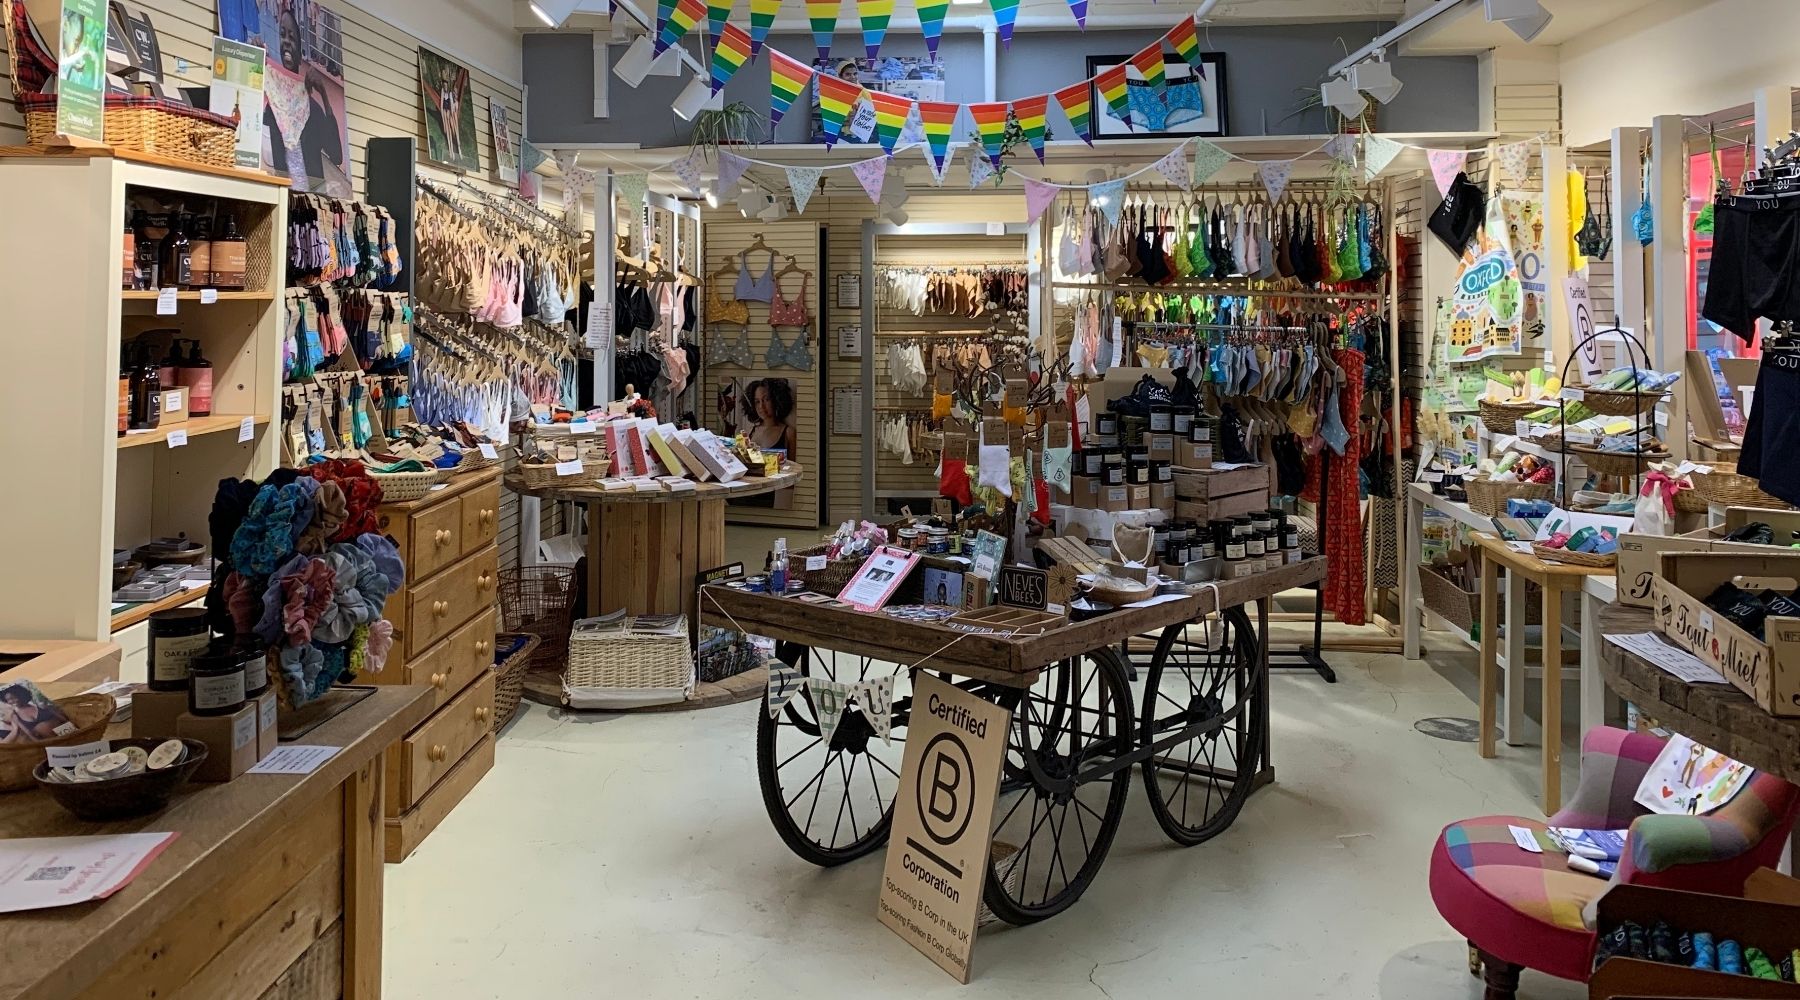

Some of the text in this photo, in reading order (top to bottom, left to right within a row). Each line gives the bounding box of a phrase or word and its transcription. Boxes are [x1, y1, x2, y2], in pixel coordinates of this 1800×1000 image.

[853, 119, 873, 132] clothes
[1756, 199, 1779, 210] YOU
[1004, 572, 1044, 605] NEVE'S
[1015, 591, 1035, 604] BEES
[1768, 597, 1795, 615] YOU
[1721, 636, 1762, 688] Miel
[928, 693, 988, 740] Certified
[928, 751, 961, 823] B
[902, 853, 960, 904] Corporation
[885, 876, 969, 945] Top-scoring B Corp in the UK
[880, 898, 967, 972] Top-scoring Fashion B Corp Globally
